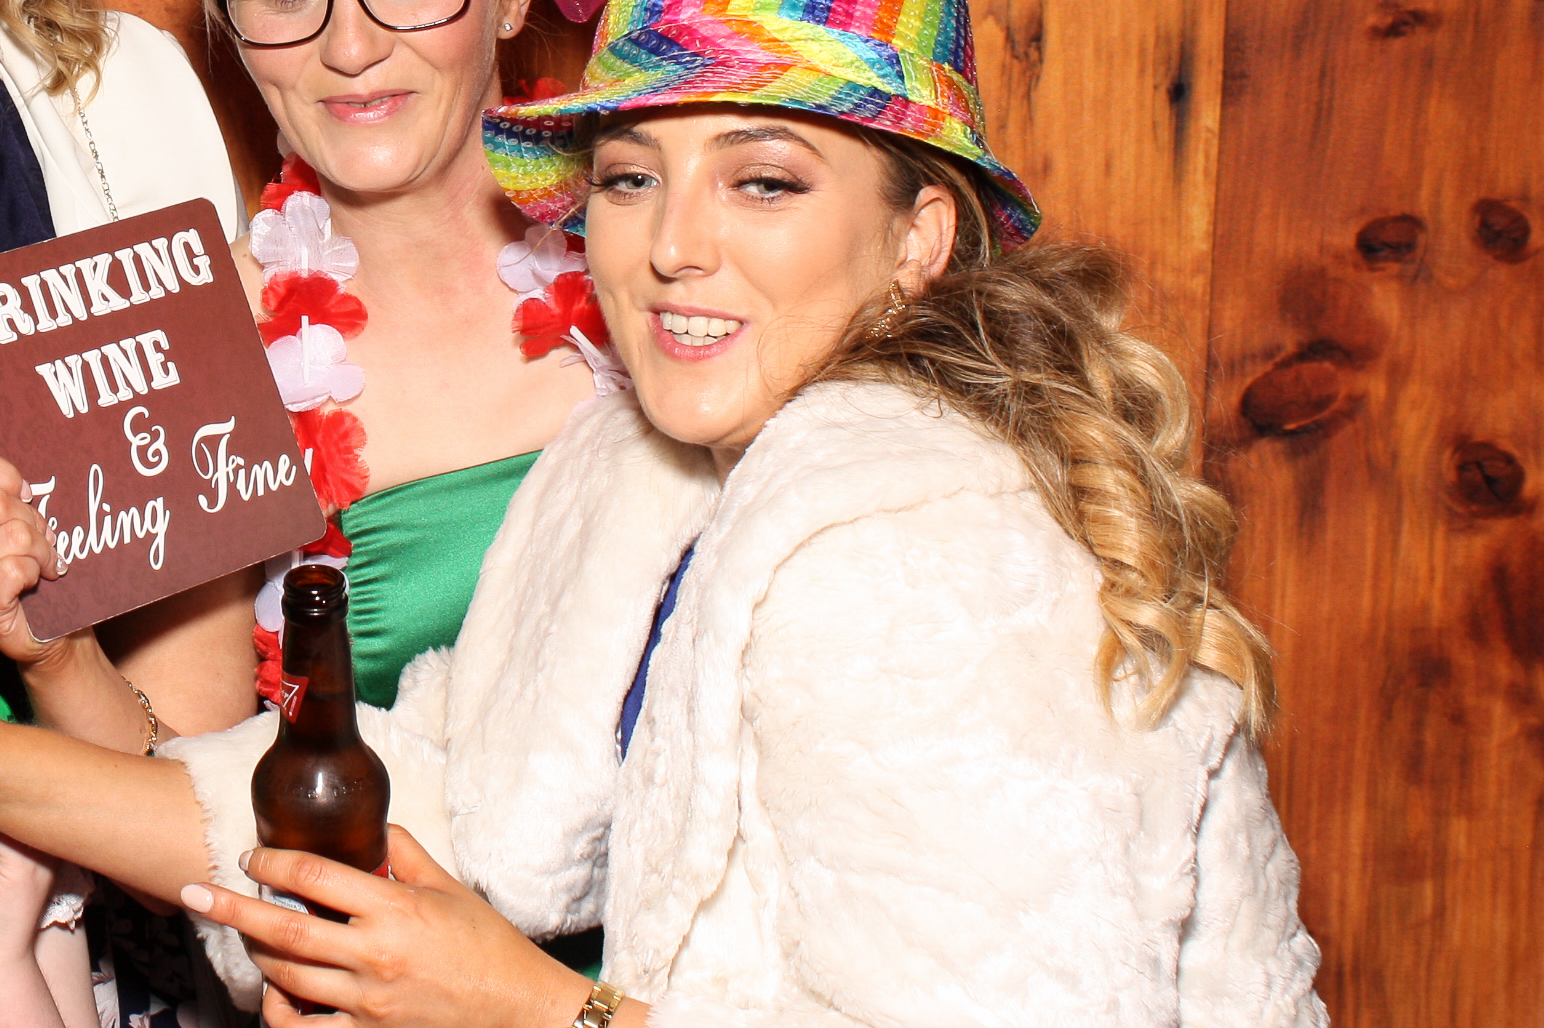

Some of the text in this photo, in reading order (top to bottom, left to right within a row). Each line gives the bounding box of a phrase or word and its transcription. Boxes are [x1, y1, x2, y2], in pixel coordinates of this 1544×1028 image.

[35, 329, 180, 418] WINE
[123, 405, 170, 477] &
[191, 415, 297, 513] Fine
